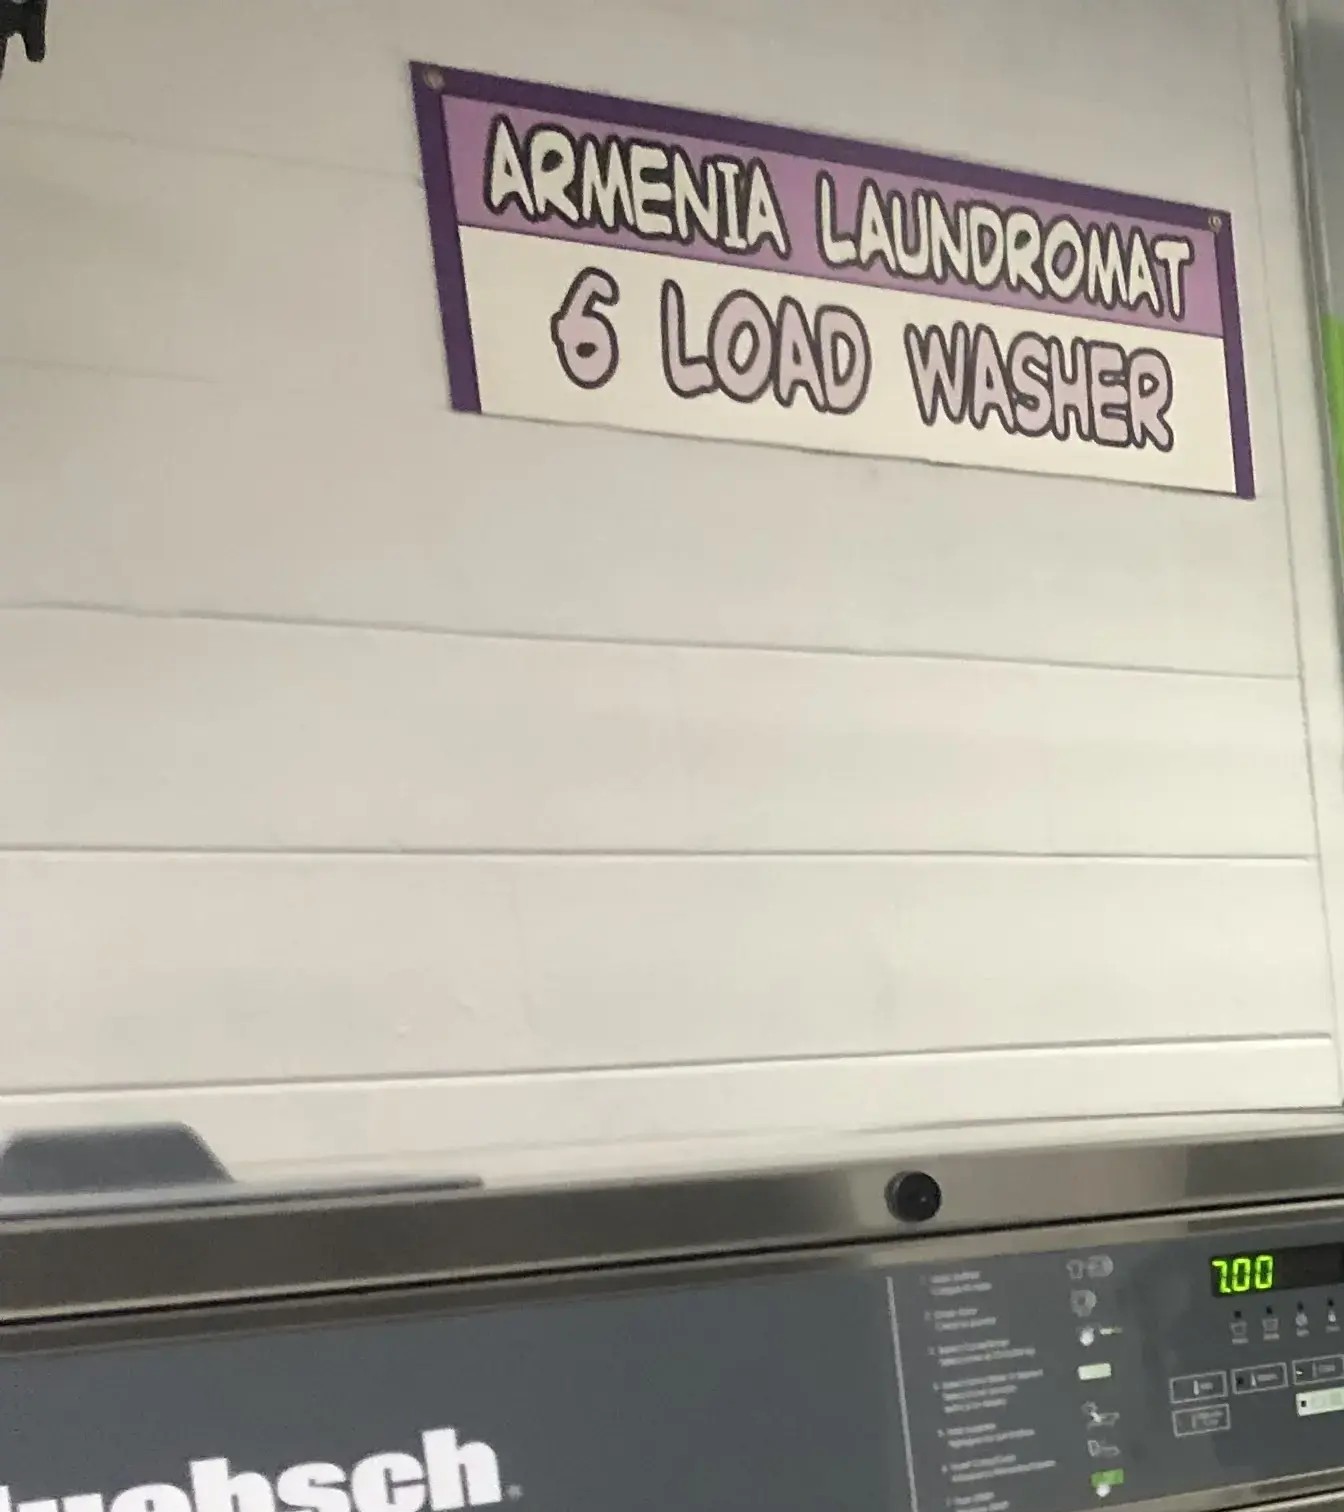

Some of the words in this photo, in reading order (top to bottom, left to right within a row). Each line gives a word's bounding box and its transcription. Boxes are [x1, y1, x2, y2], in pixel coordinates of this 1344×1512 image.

[484, 114, 788, 257] ARMENIA
[814, 170, 1194, 319] LAUNDROMAT
[551, 266, 620, 388] 6
[661, 279, 870, 414] LOAD
[906, 322, 1174, 451] WASHER
